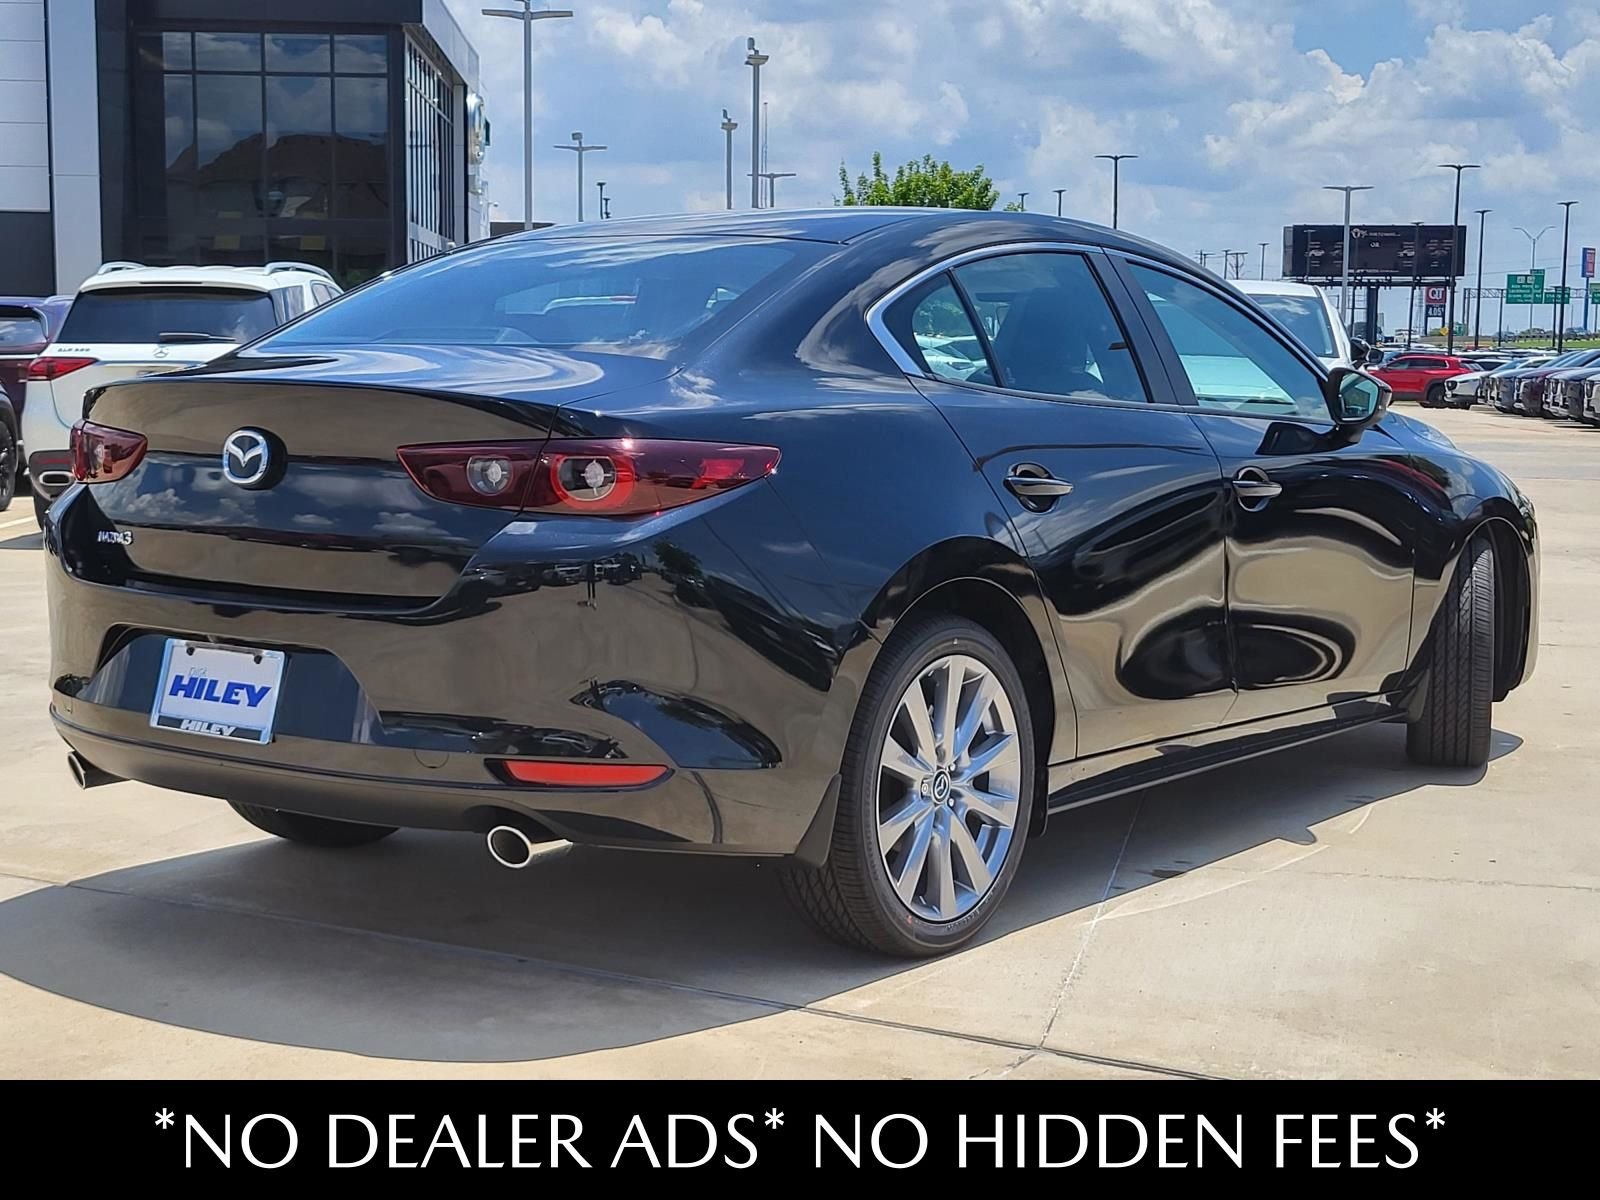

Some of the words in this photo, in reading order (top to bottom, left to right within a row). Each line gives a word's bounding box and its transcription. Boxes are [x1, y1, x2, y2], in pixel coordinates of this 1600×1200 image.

[1429, 287, 1444, 300] QT
[169, 675, 272, 707] HILEY
[181, 719, 236, 736] HILEY
